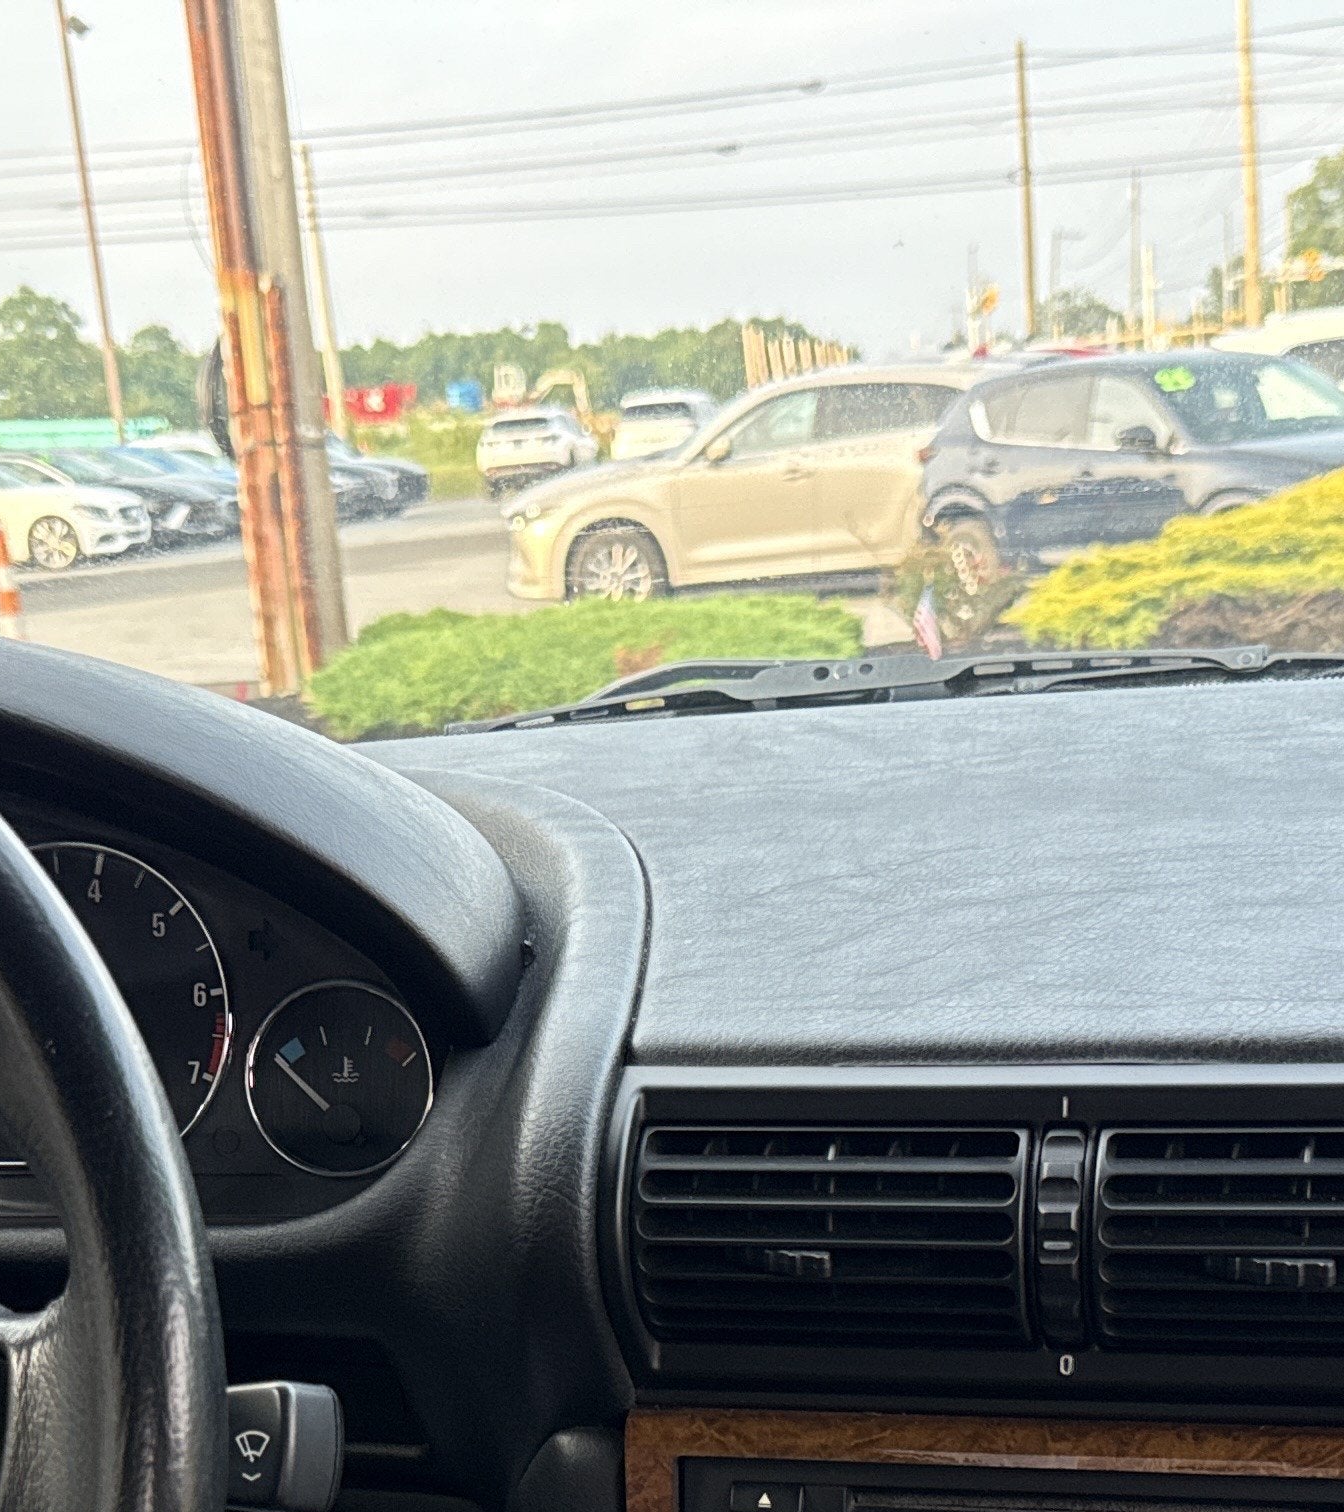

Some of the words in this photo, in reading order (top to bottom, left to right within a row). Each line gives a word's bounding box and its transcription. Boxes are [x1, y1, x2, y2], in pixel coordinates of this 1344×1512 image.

[88, 878, 102, 902] 4
[152, 913, 165, 938] 5
[193, 982, 206, 1007] 6
[188, 1060, 200, 1085] 7
[1059, 1354, 1076, 1376] 0
